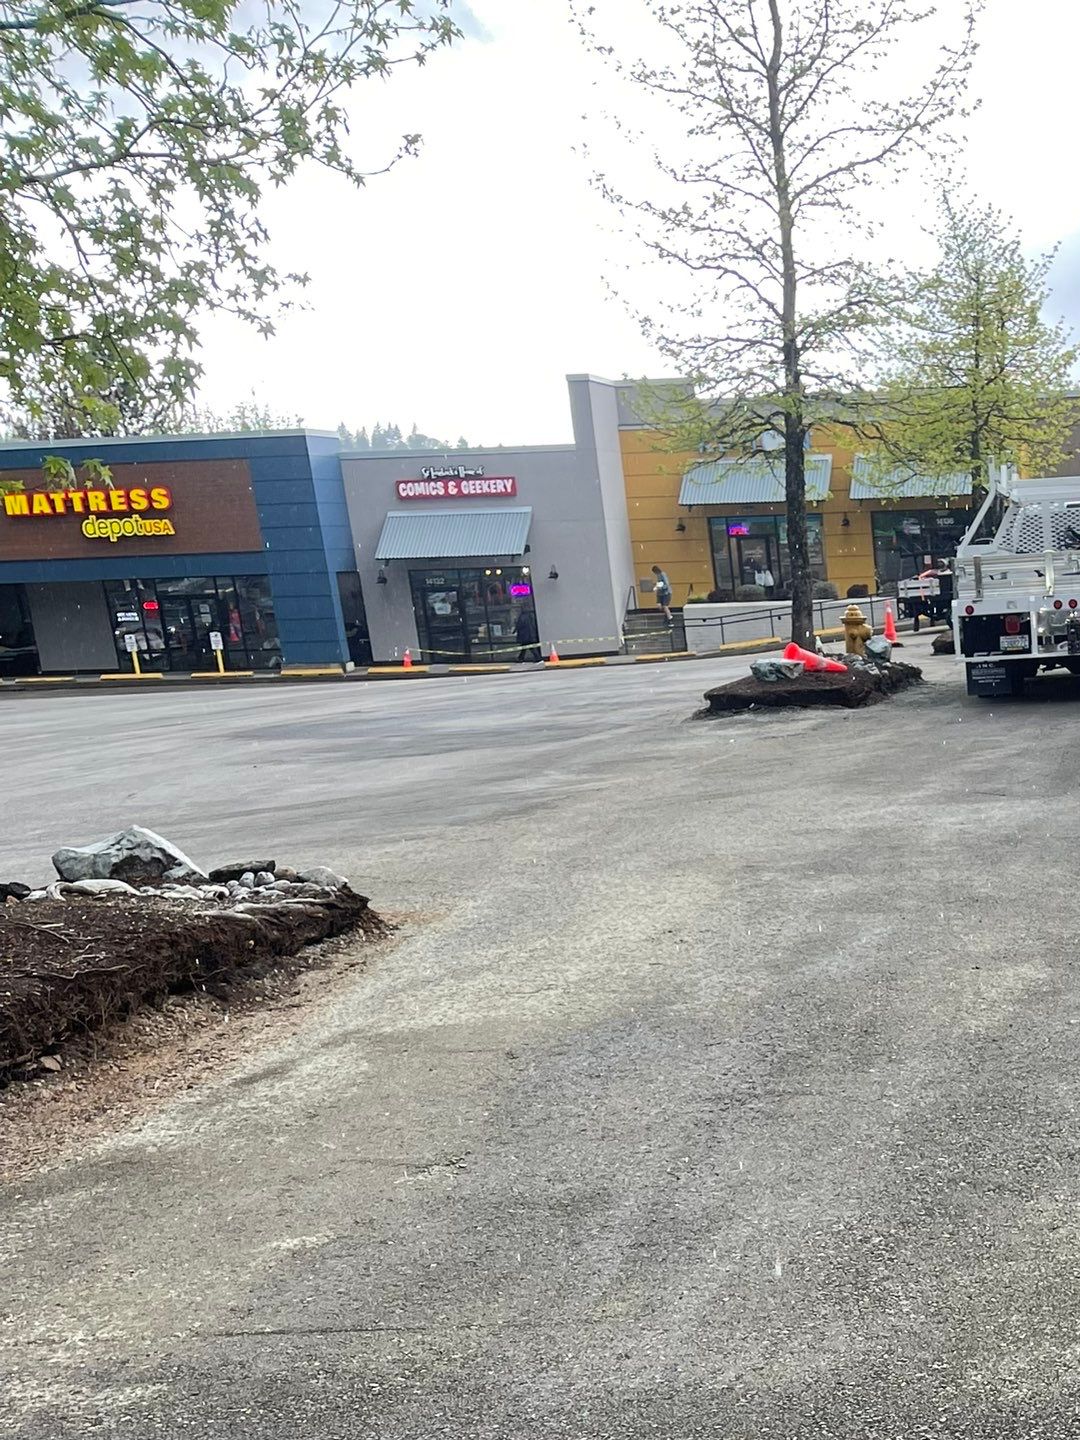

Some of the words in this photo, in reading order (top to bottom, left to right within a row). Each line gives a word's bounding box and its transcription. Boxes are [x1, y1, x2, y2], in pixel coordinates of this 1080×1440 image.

[398, 481, 445, 497] COMICS
[447, 480, 459, 495] &
[460, 479, 513, 494] GEEKERY
[4, 486, 172, 516] MATTRESS
